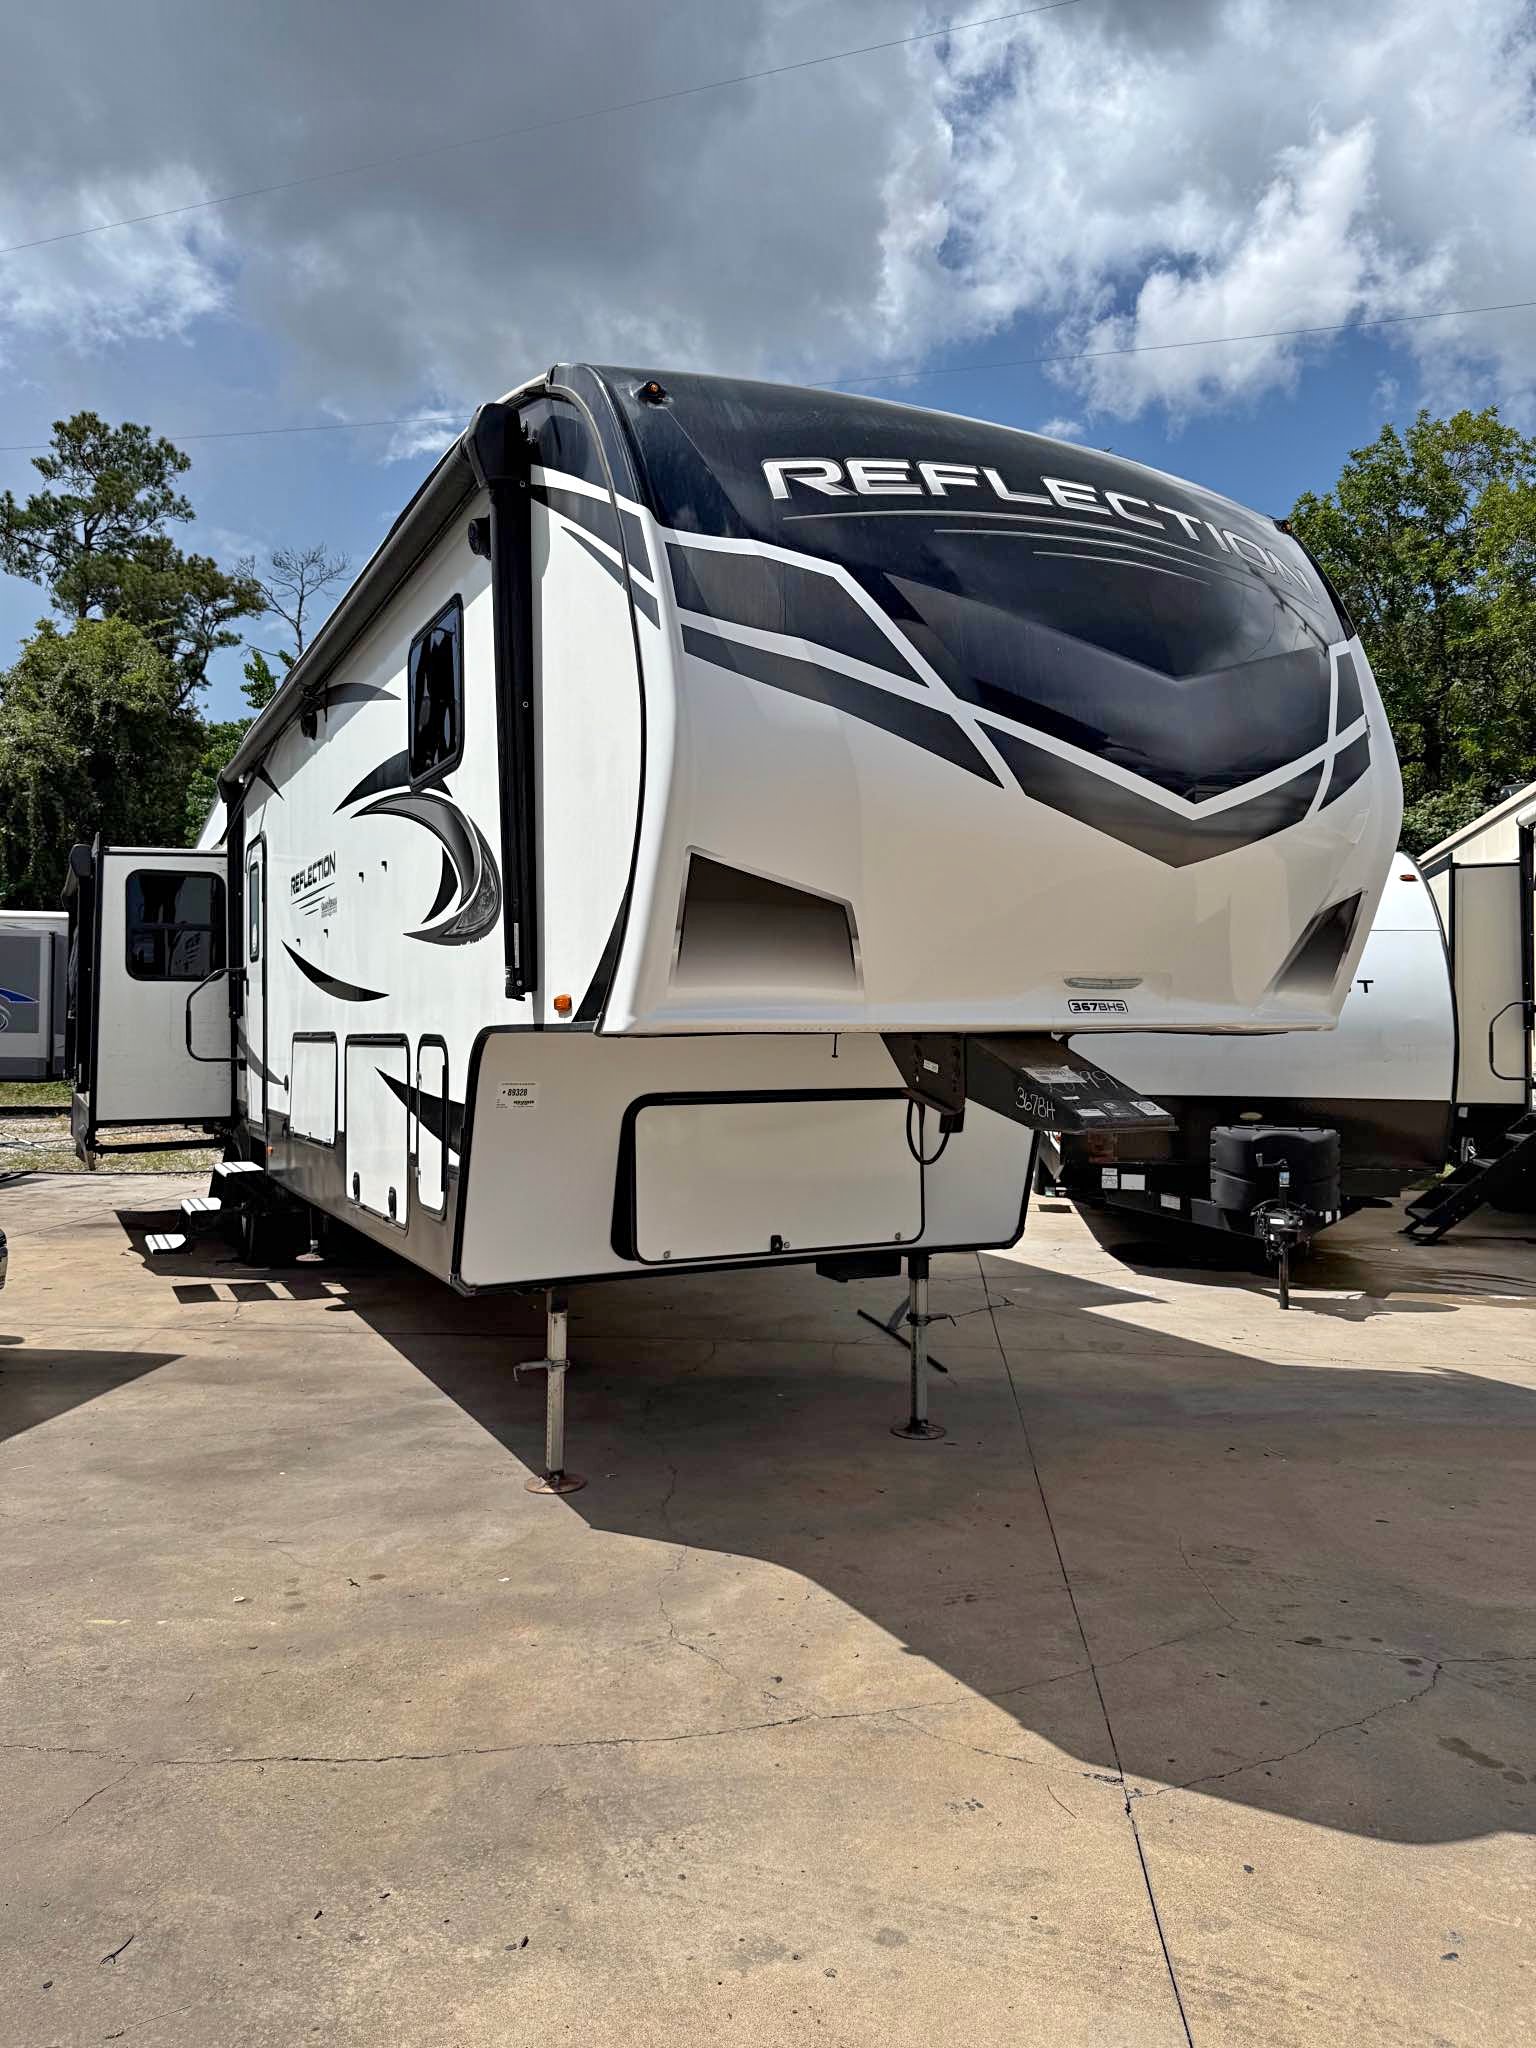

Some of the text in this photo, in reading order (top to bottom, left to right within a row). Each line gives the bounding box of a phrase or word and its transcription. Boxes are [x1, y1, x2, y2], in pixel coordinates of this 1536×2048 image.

[760, 456, 1320, 604] REFLECTION
[290, 849, 336, 897] REFLECTION
[1071, 1002, 1125, 1012] 367BHS
